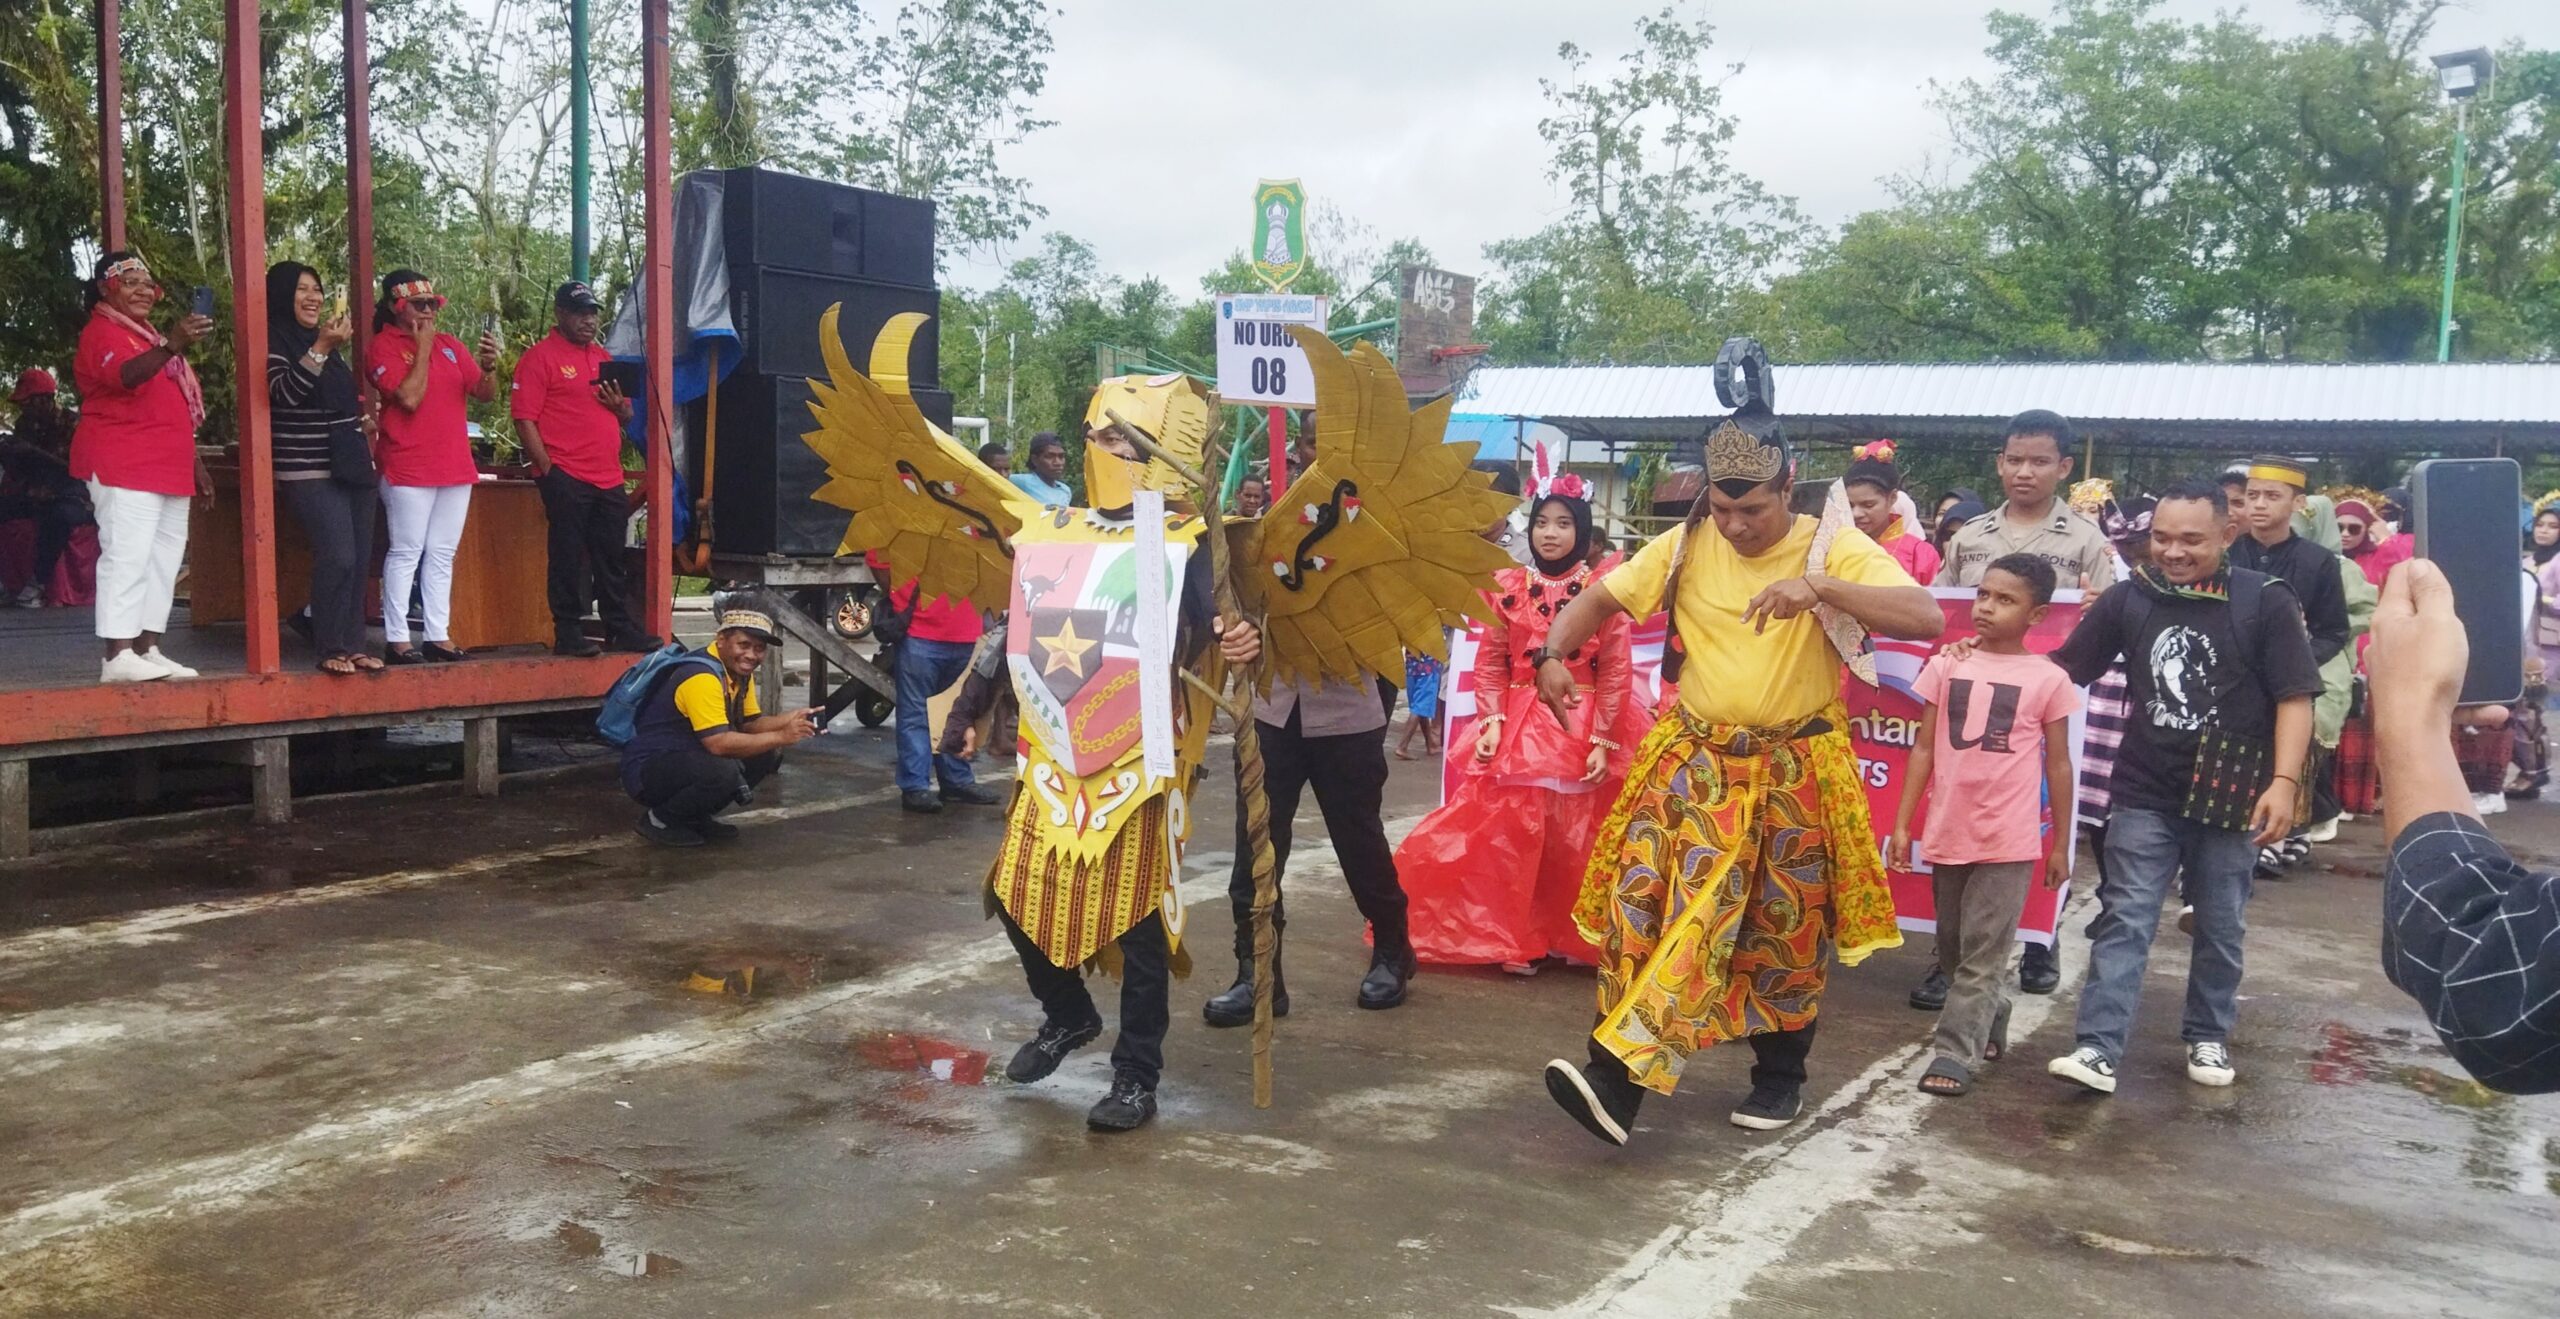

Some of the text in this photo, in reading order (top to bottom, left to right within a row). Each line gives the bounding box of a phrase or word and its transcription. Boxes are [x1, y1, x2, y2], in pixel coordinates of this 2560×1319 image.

[1234, 321, 1304, 347] NO URU
[1252, 357, 1286, 395] 08
